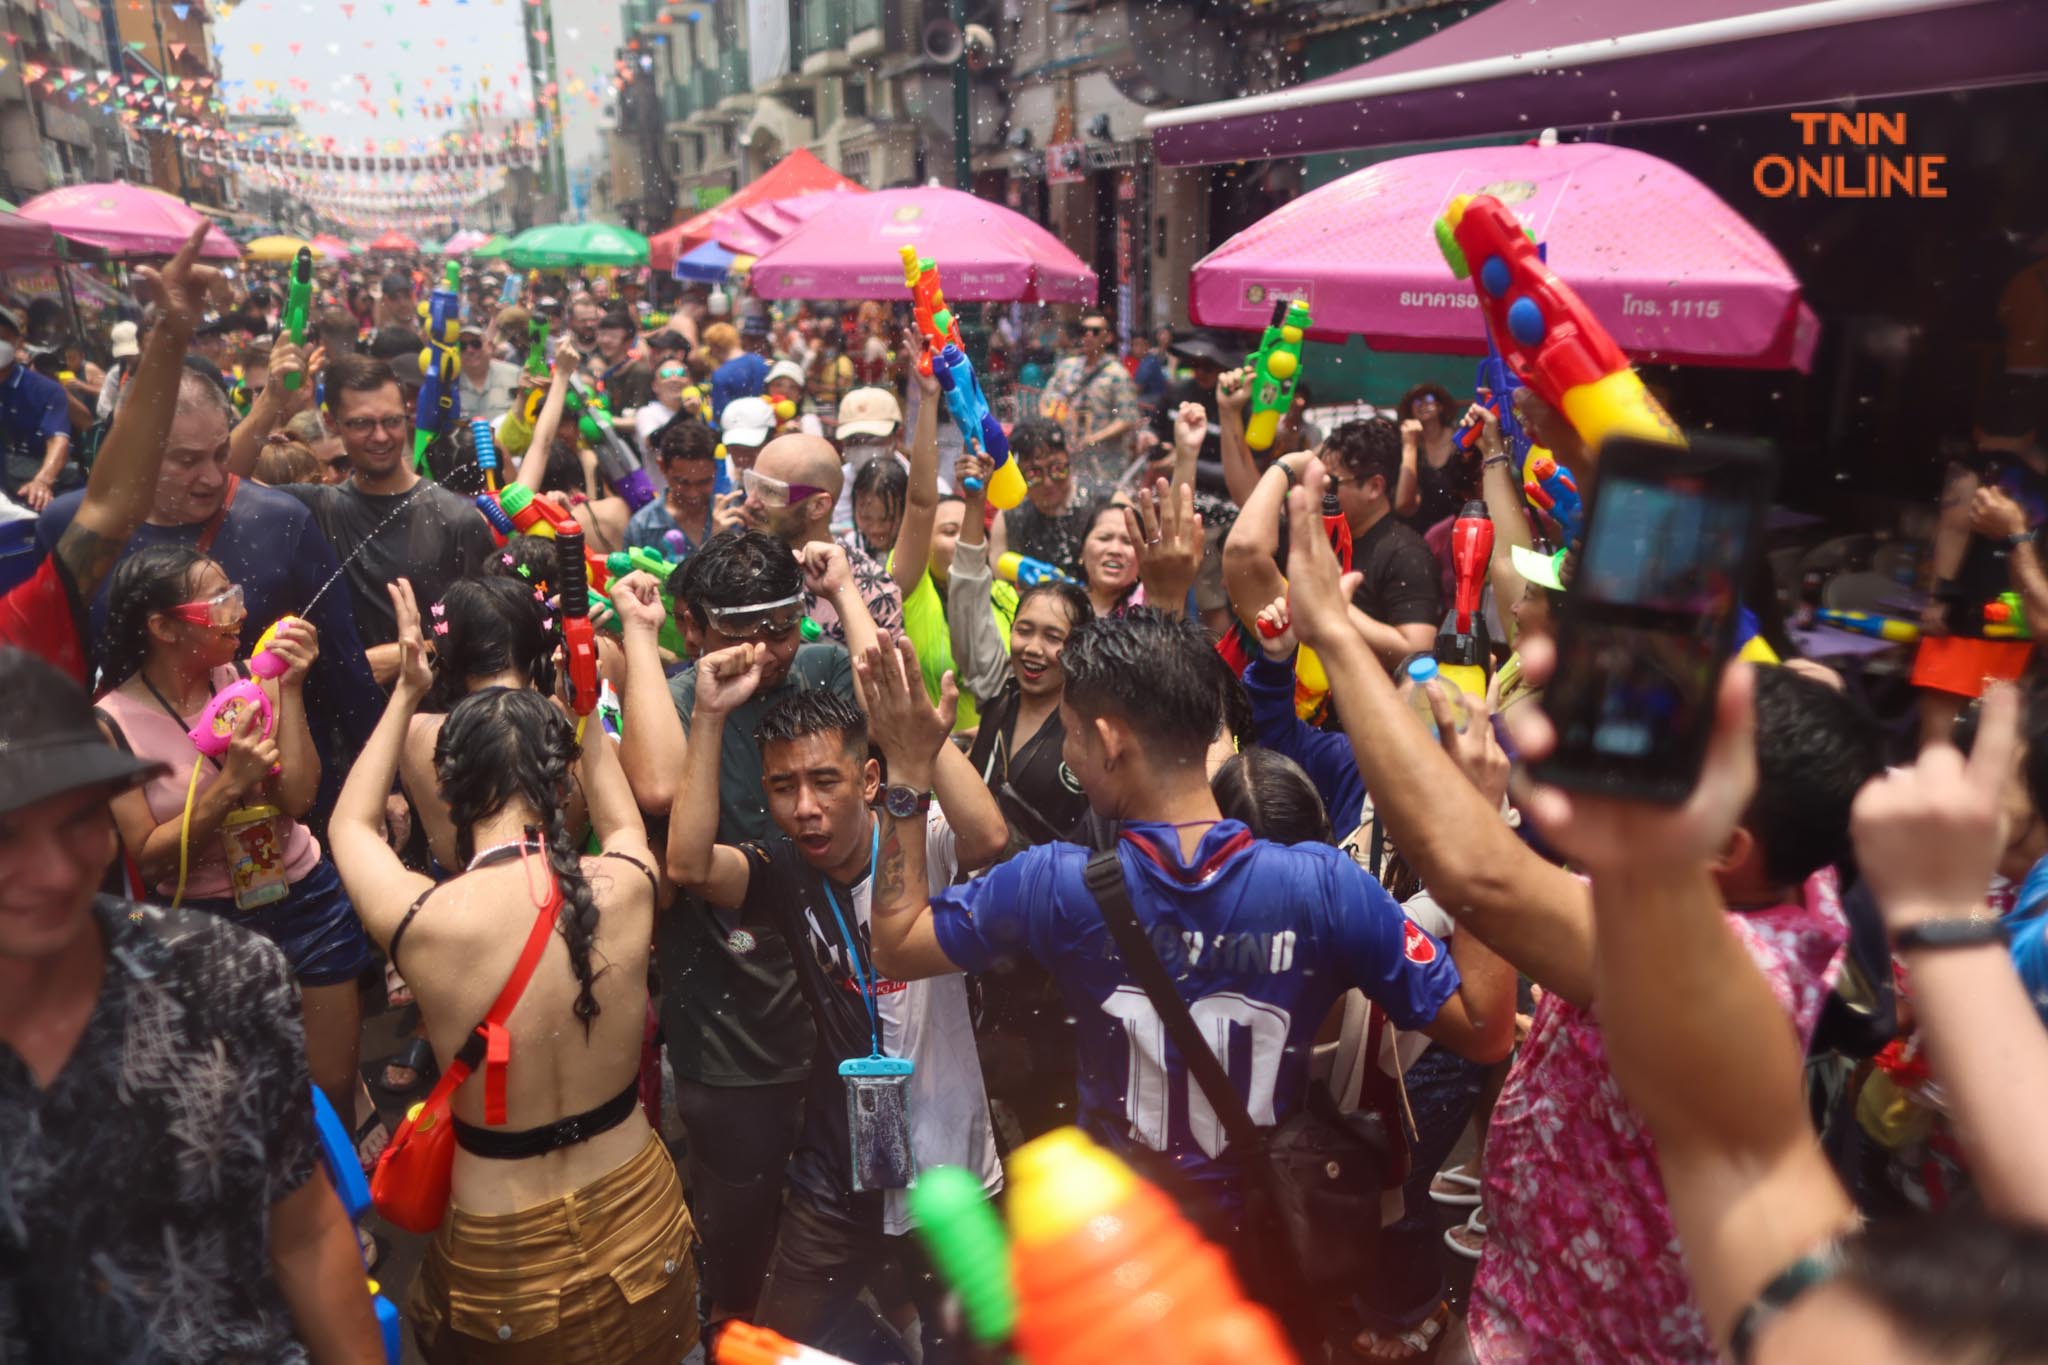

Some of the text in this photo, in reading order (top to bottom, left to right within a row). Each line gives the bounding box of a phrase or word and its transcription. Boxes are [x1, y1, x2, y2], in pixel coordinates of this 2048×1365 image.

[1400, 291, 1479, 309] ธนาคารอ
[1669, 299, 1721, 319] 1115
[1101, 984, 1291, 1160] 10
